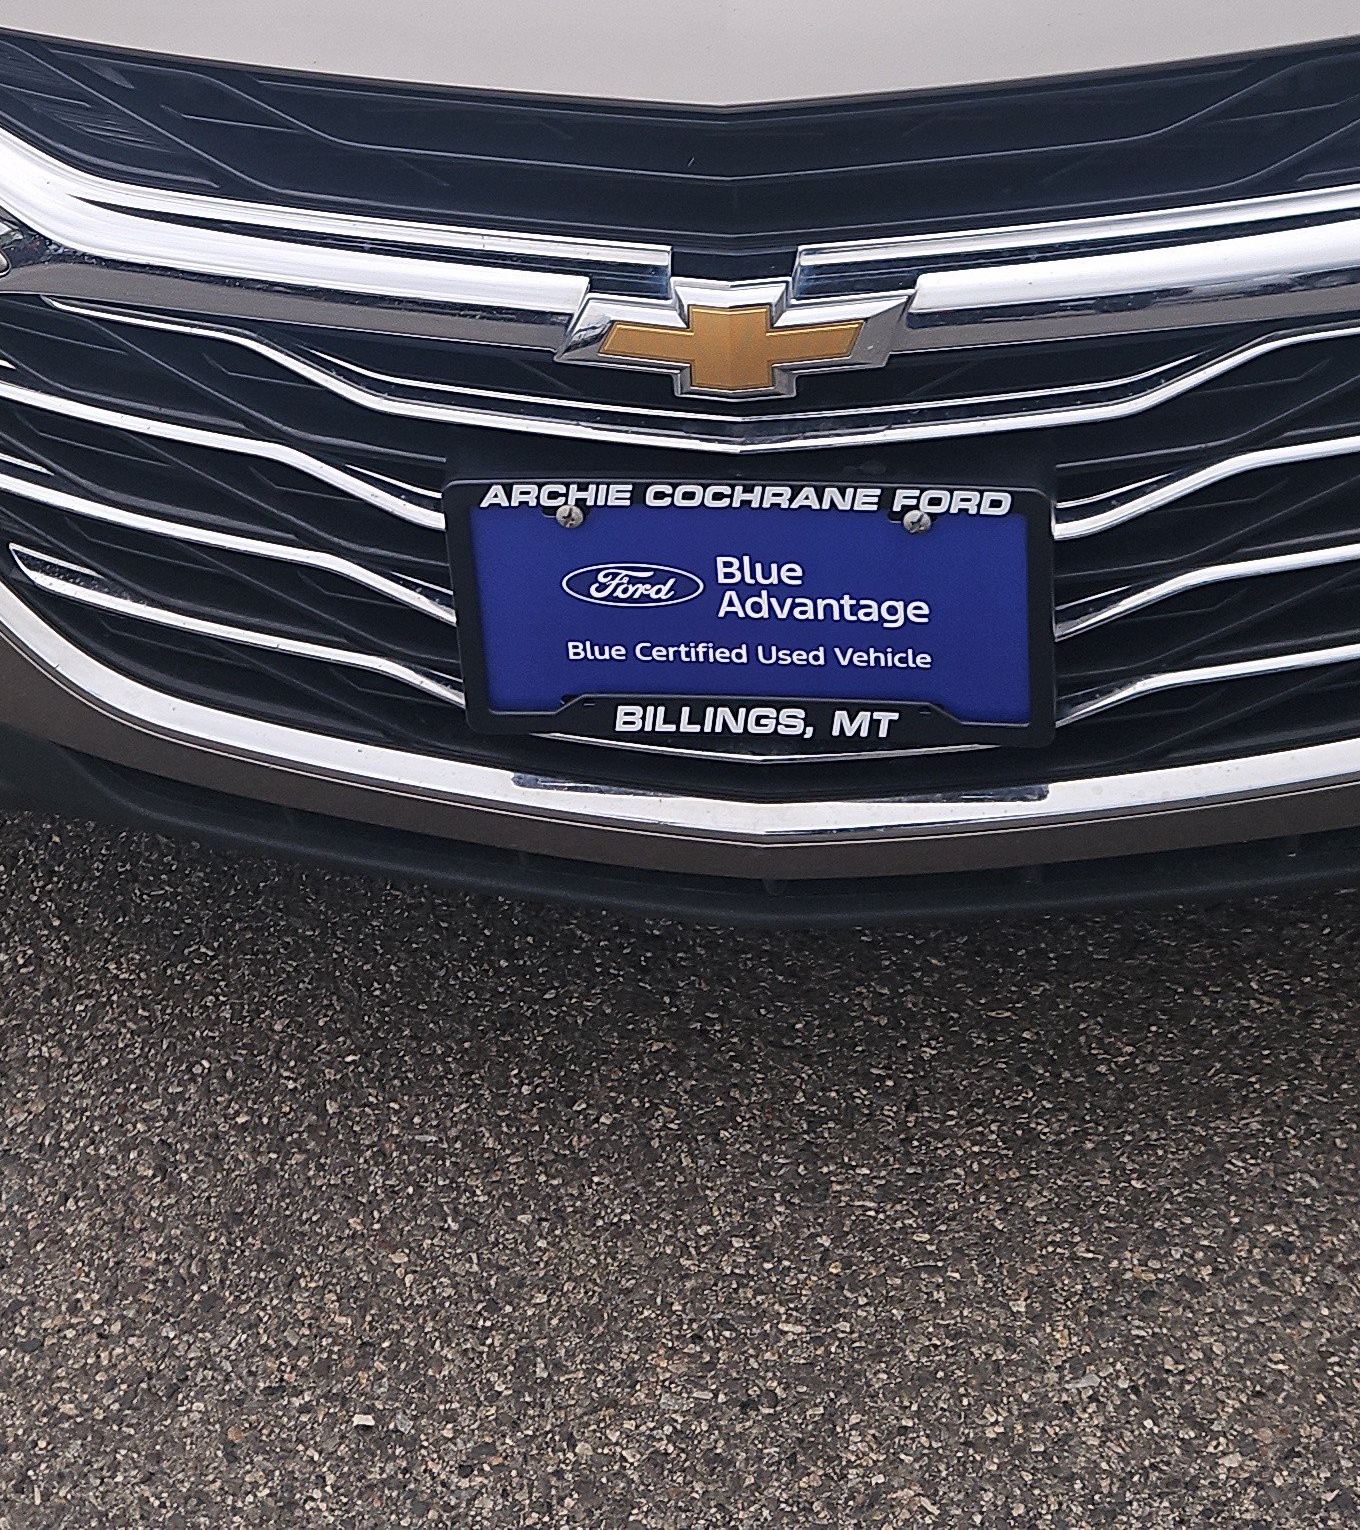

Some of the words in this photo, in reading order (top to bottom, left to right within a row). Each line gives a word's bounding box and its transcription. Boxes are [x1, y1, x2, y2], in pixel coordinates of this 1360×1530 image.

[480, 484, 632, 507] ARCHIE
[644, 484, 882, 512] COCHRANE
[892, 489, 1013, 517] FORD
[589, 568, 676, 600] Ford
[715, 555, 803, 586] Blue
[717, 589, 931, 628] Advantage
[567, 640, 627, 661] Blue
[635, 641, 748, 665] Certified
[757, 644, 825, 667] Used
[833, 646, 932, 669] Vehicle
[614, 705, 814, 739] BILLINGS,
[831, 710, 900, 739] MT
